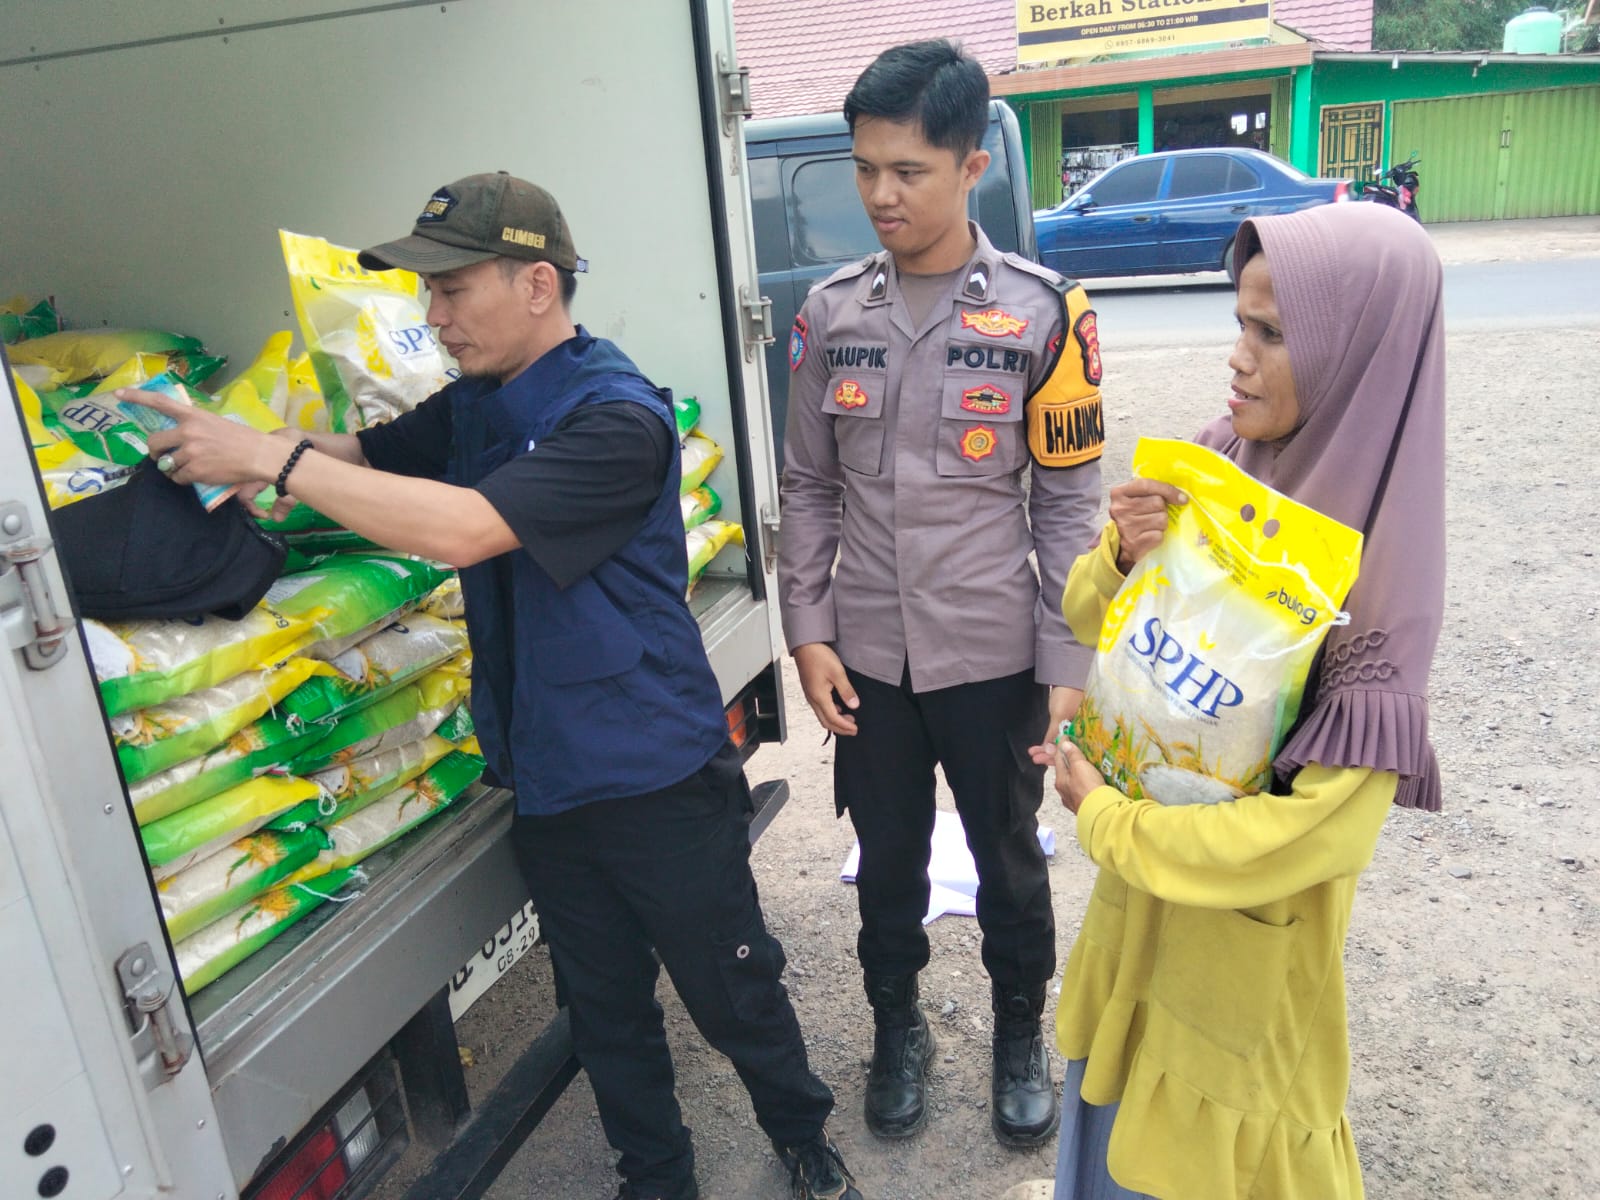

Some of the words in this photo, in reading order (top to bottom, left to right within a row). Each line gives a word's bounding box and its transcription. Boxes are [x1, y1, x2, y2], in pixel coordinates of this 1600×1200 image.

[1030, 0, 1112, 23] Berkah
[1080, 26, 1099, 36] OPEN
[1099, 24, 1117, 34] DAILY
[1117, 22, 1137, 32] FROM
[1156, 19, 1165, 27] TO
[1185, 15, 1199, 23] WIB
[502, 226, 546, 249] CLIMBER
[826, 346, 888, 369] TAUPIK
[947, 346, 1028, 373] POLRI
[1044, 401, 1105, 455] BHABINK
[1278, 587, 1318, 626] bulog
[1128, 617, 1244, 719] SPHP
